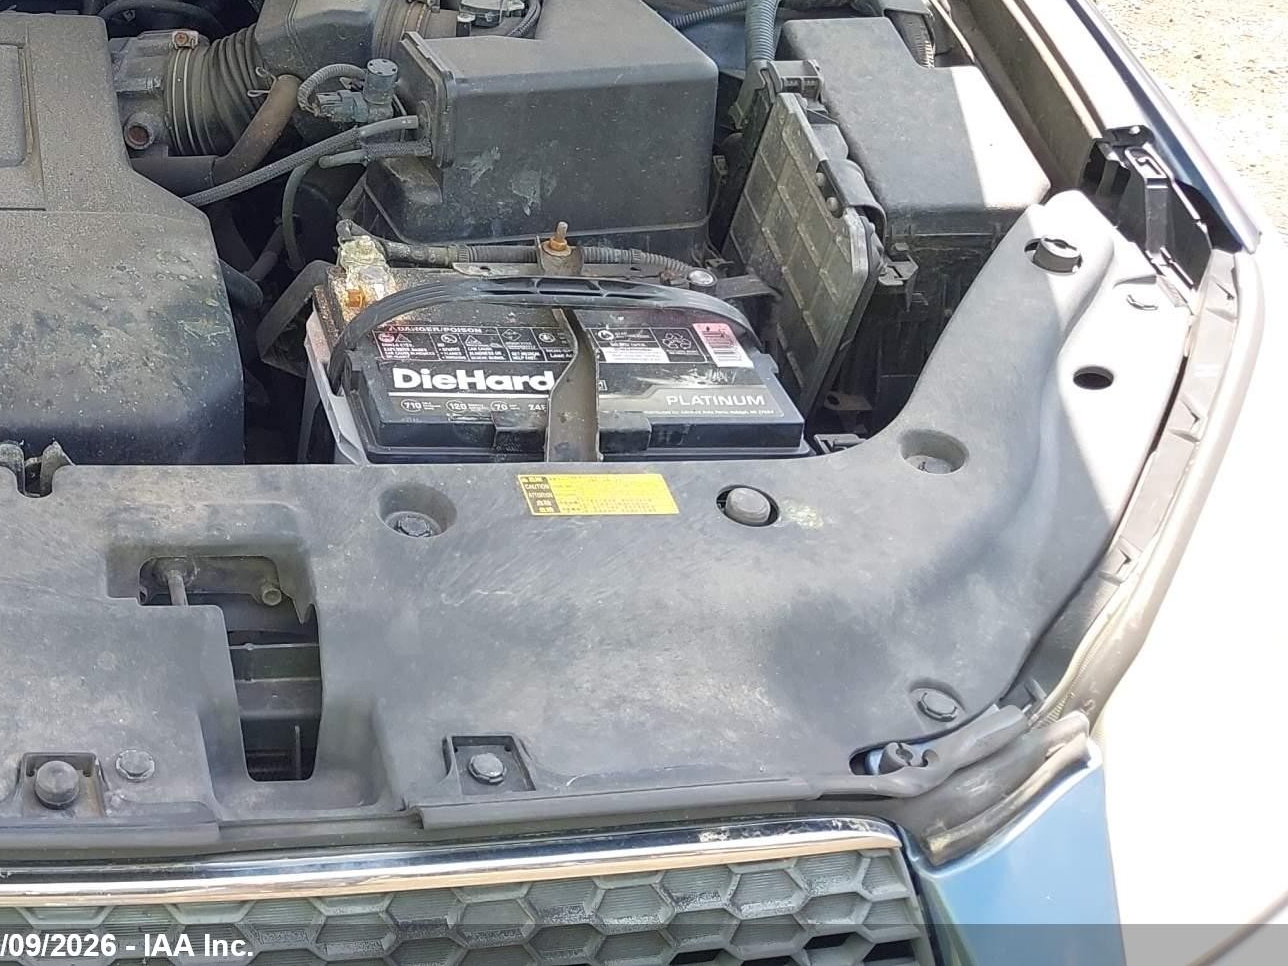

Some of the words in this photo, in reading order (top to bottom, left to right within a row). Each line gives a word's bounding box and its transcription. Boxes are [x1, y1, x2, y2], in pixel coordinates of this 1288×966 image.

[392, 367, 556, 392] DieHard
[403, 400, 423, 410] 710
[449, 401, 468, 411] 120
[494, 403, 509, 412] 70
[666, 395, 766, 407] PLATINUM
